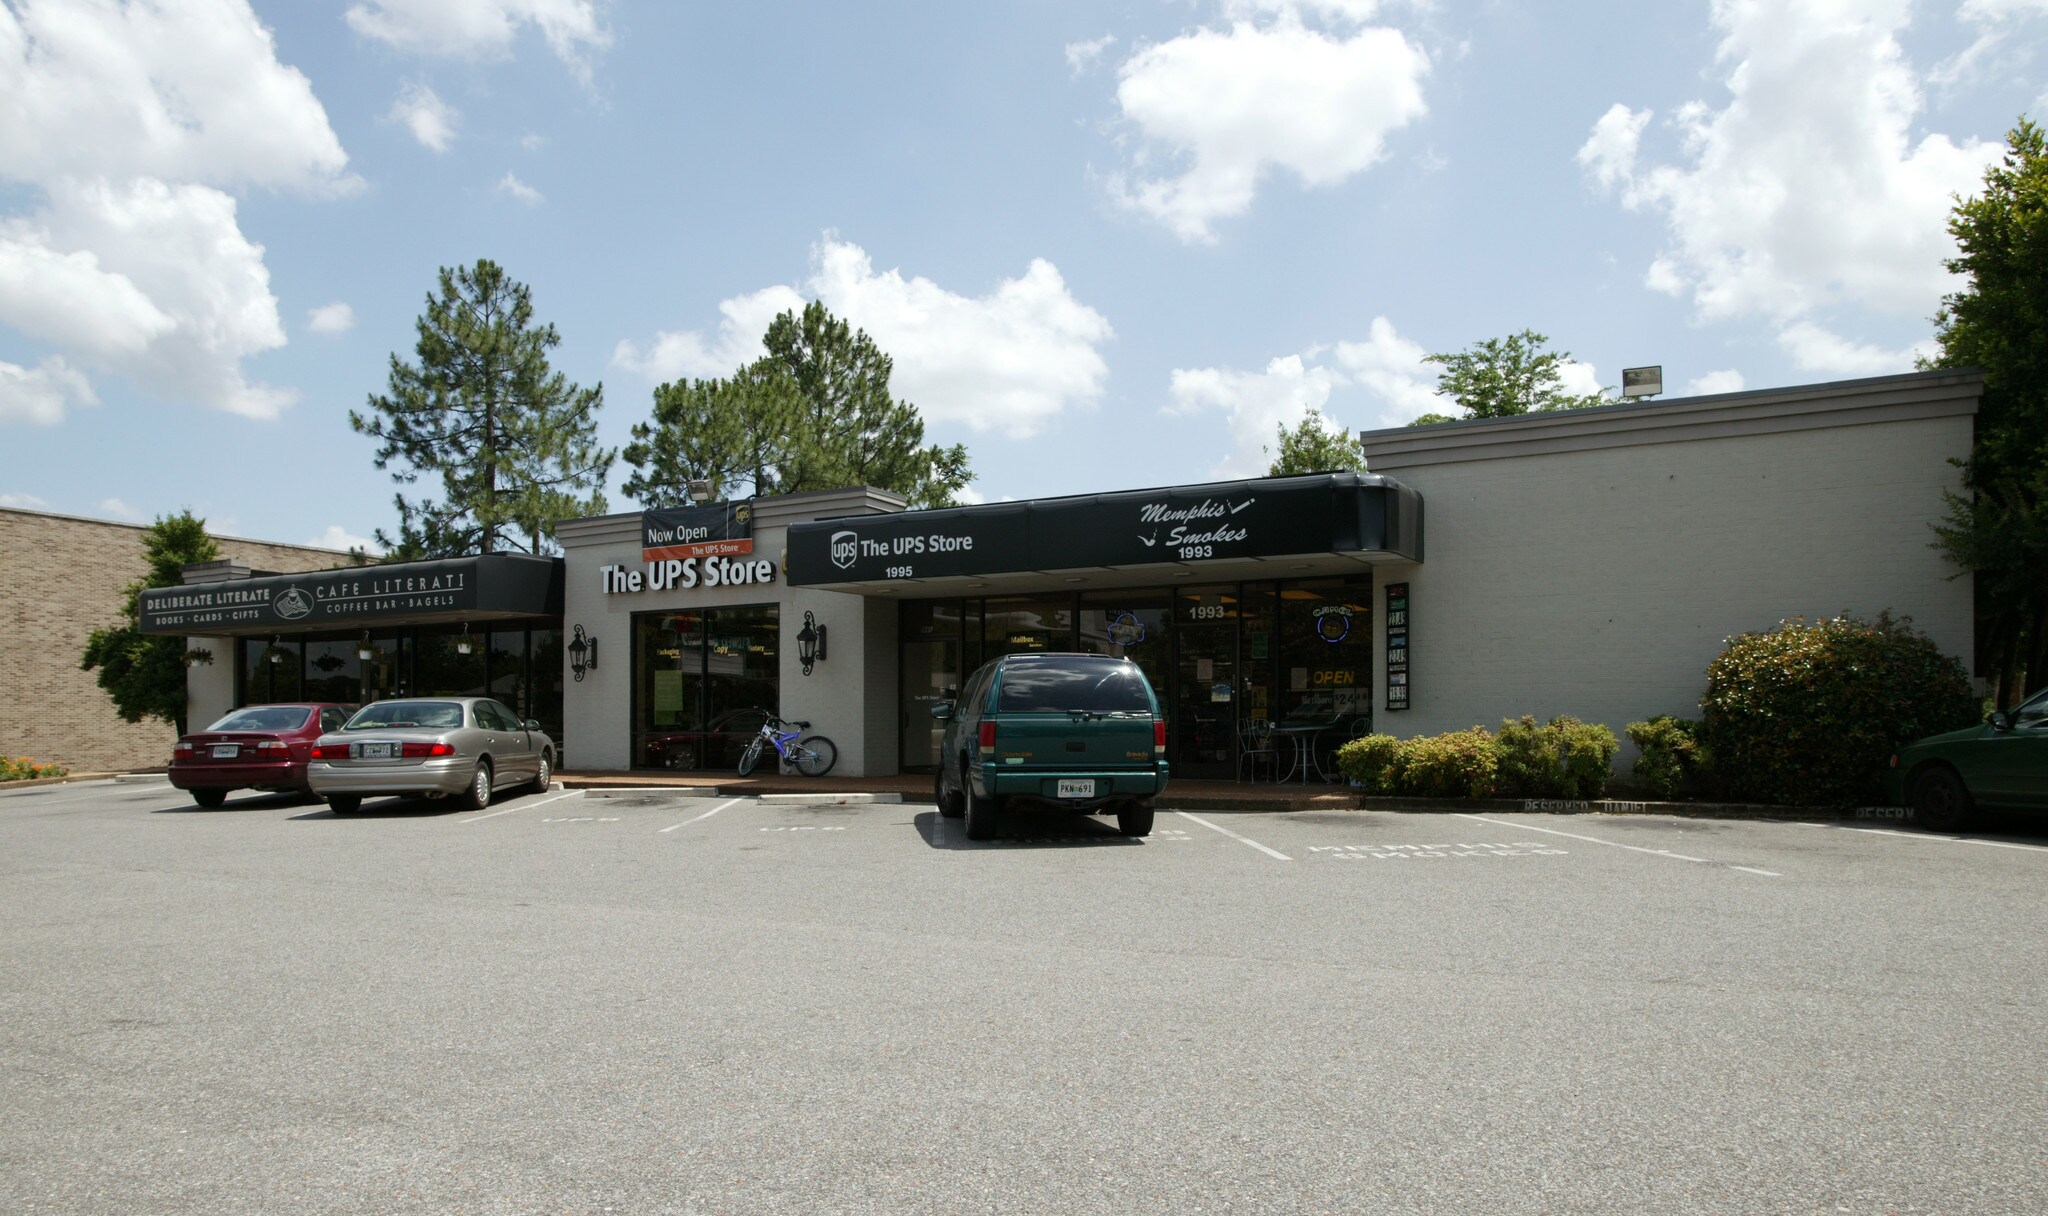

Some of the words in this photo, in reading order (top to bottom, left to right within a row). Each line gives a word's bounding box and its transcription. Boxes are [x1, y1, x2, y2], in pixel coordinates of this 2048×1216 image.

[1141, 499, 1225, 525] Memphis
[648, 528, 673, 543] Now
[677, 525, 708, 543] Open
[1165, 523, 1248, 546] Smokes
[692, 546, 704, 555] The
[705, 545, 719, 554] UPS
[720, 544, 738, 553] Store
[833, 542, 855, 563] ups
[861, 540, 889, 557] The
[894, 536, 924, 554] UPS
[929, 534, 973, 553] Store
[1178, 545, 1213, 559] 1993
[600, 564, 642, 594] The
[649, 557, 698, 591] UPS
[704, 556, 772, 587] Store
[885, 565, 913, 578] 1995
[316, 582, 359, 599] CAFE
[374, 573, 464, 594] LITERATI
[147, 594, 212, 610] DELIBERATE
[217, 589, 270, 605] LITERATE
[326, 601, 368, 613] COFFEE
[376, 599, 396, 610] BAR
[409, 596, 454, 608] BAGELS
[156, 615, 184, 625] BOOKS
[193, 612, 223, 623] CARDS
[232, 610, 259, 620] GIFTS
[1189, 605, 1225, 620] 1993
[1312, 605, 1354, 617] CAMEL
[1010, 635, 1034, 643] Mailbox
[713, 645, 729, 654] Copy
[1313, 671, 1355, 685] OPEN
[1524, 799, 1589, 811] RESERVED
[1856, 806, 1915, 818] RESERV
